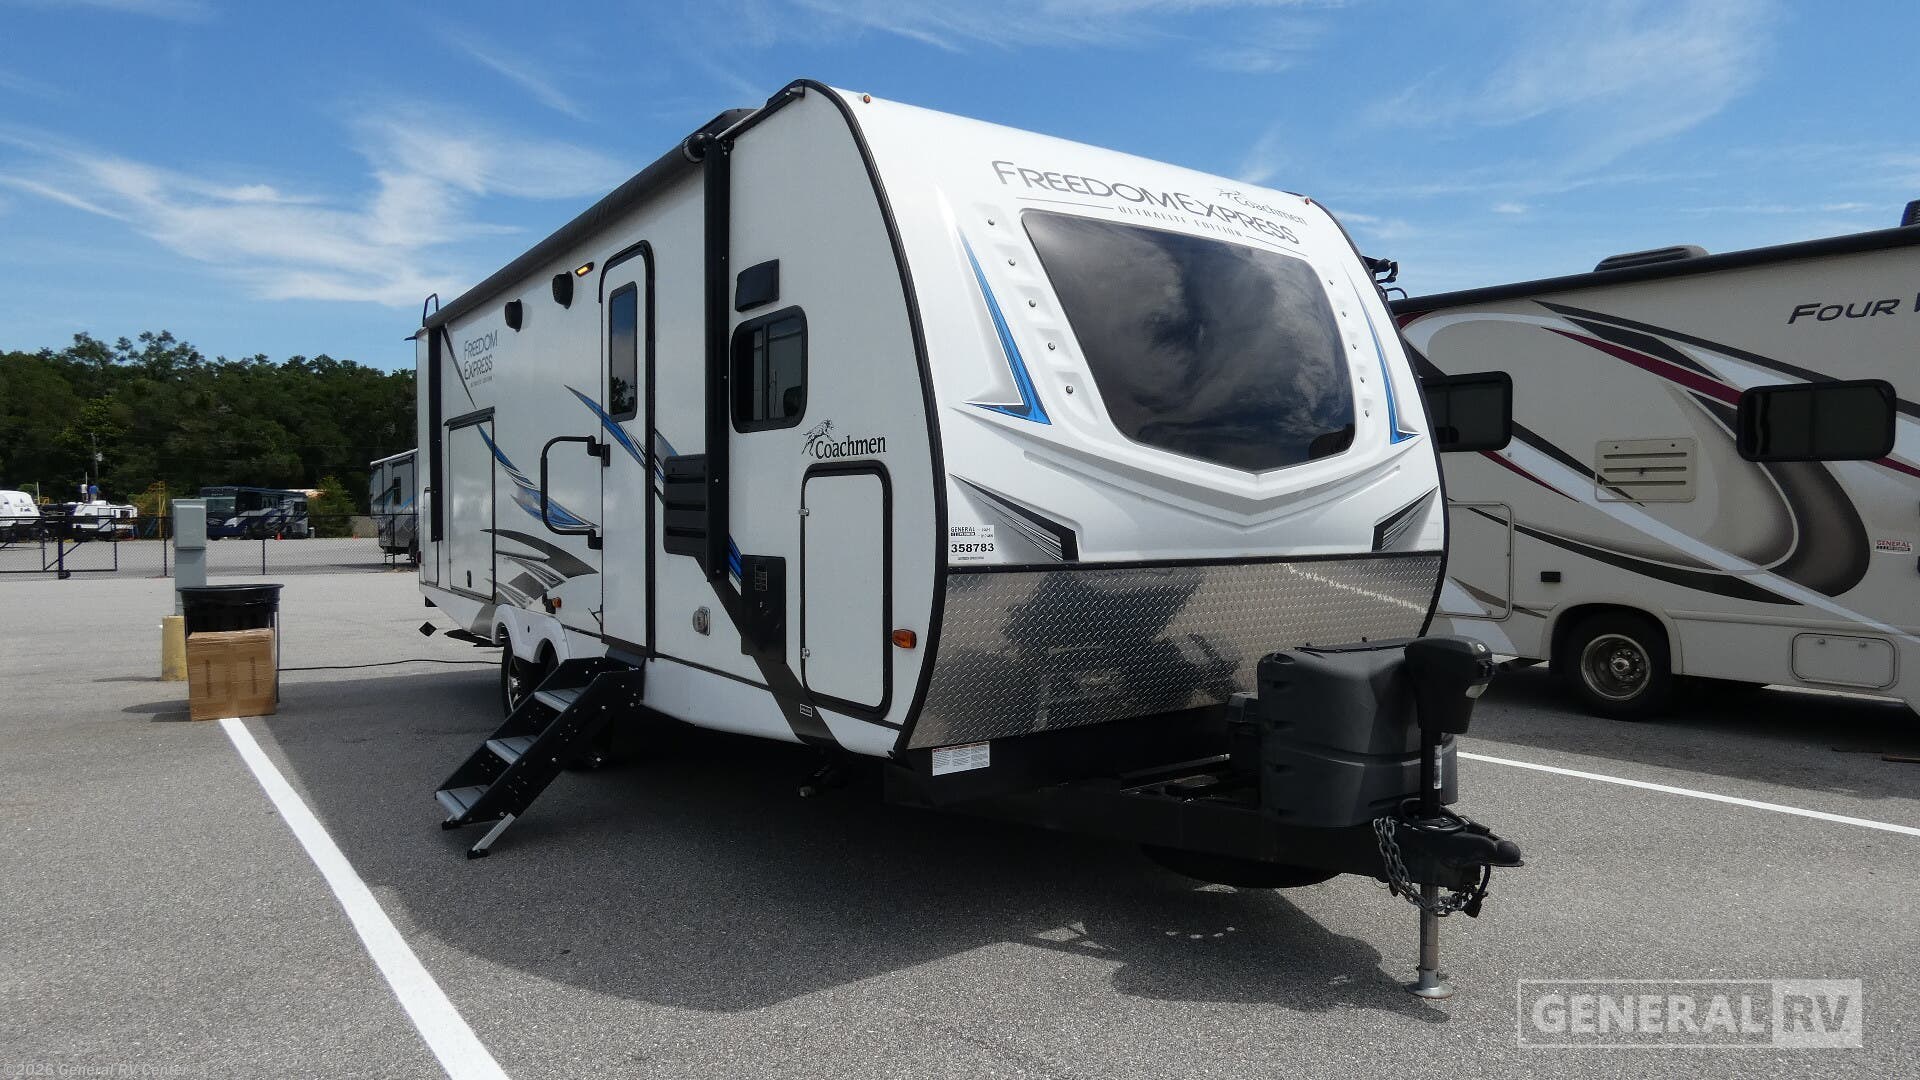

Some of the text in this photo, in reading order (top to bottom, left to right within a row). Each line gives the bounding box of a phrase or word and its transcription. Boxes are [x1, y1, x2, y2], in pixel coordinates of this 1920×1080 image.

[1787, 299, 1900, 325] FOUR
[464, 329, 498, 361] FREEDOM
[464, 353, 493, 380] EXPRESS
[815, 434, 887, 460] Coachmen
[951, 543, 995, 553] 358783
